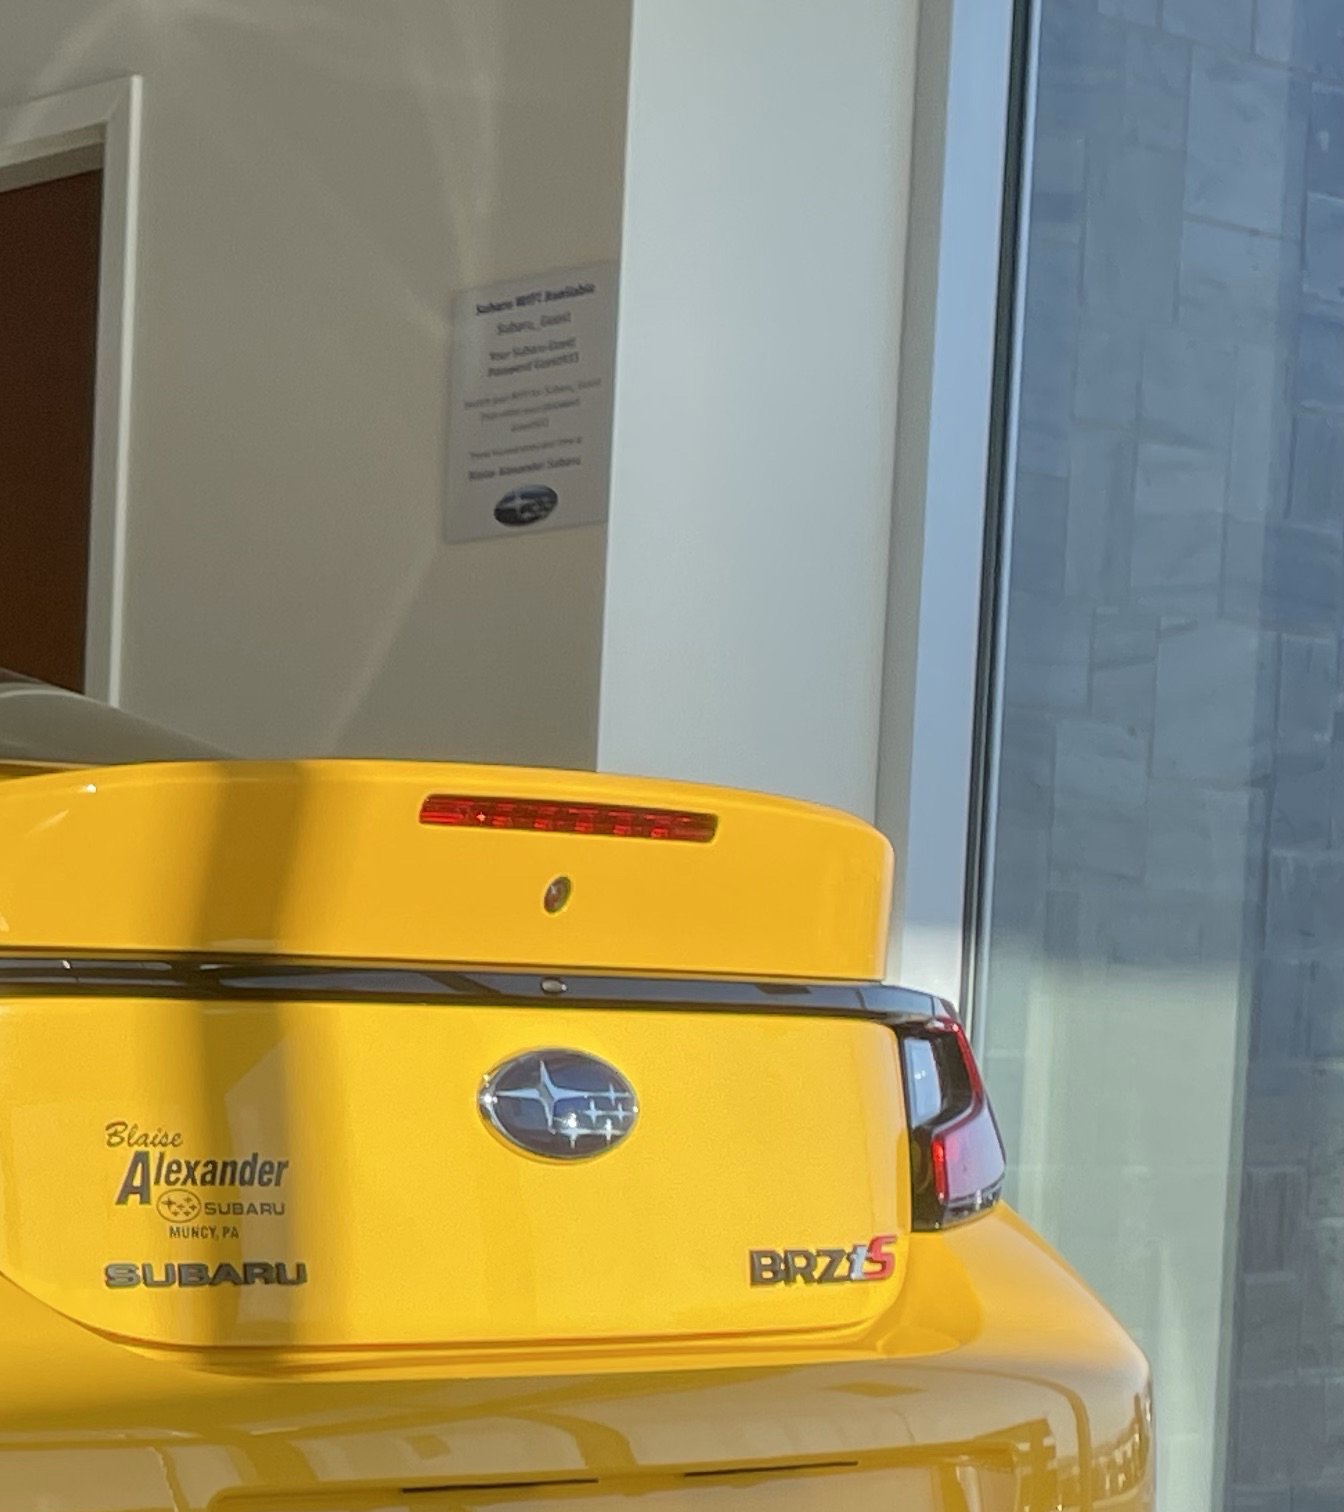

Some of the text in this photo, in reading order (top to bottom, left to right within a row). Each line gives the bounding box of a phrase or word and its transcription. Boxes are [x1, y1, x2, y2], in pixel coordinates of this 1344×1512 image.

[105, 1120, 184, 1148] Blaise
[115, 1150, 289, 1206] Alexander
[204, 1202, 285, 1216] SUBARU
[169, 1226, 240, 1240] MUNCY, PA
[104, 1262, 308, 1288] SUBARU
